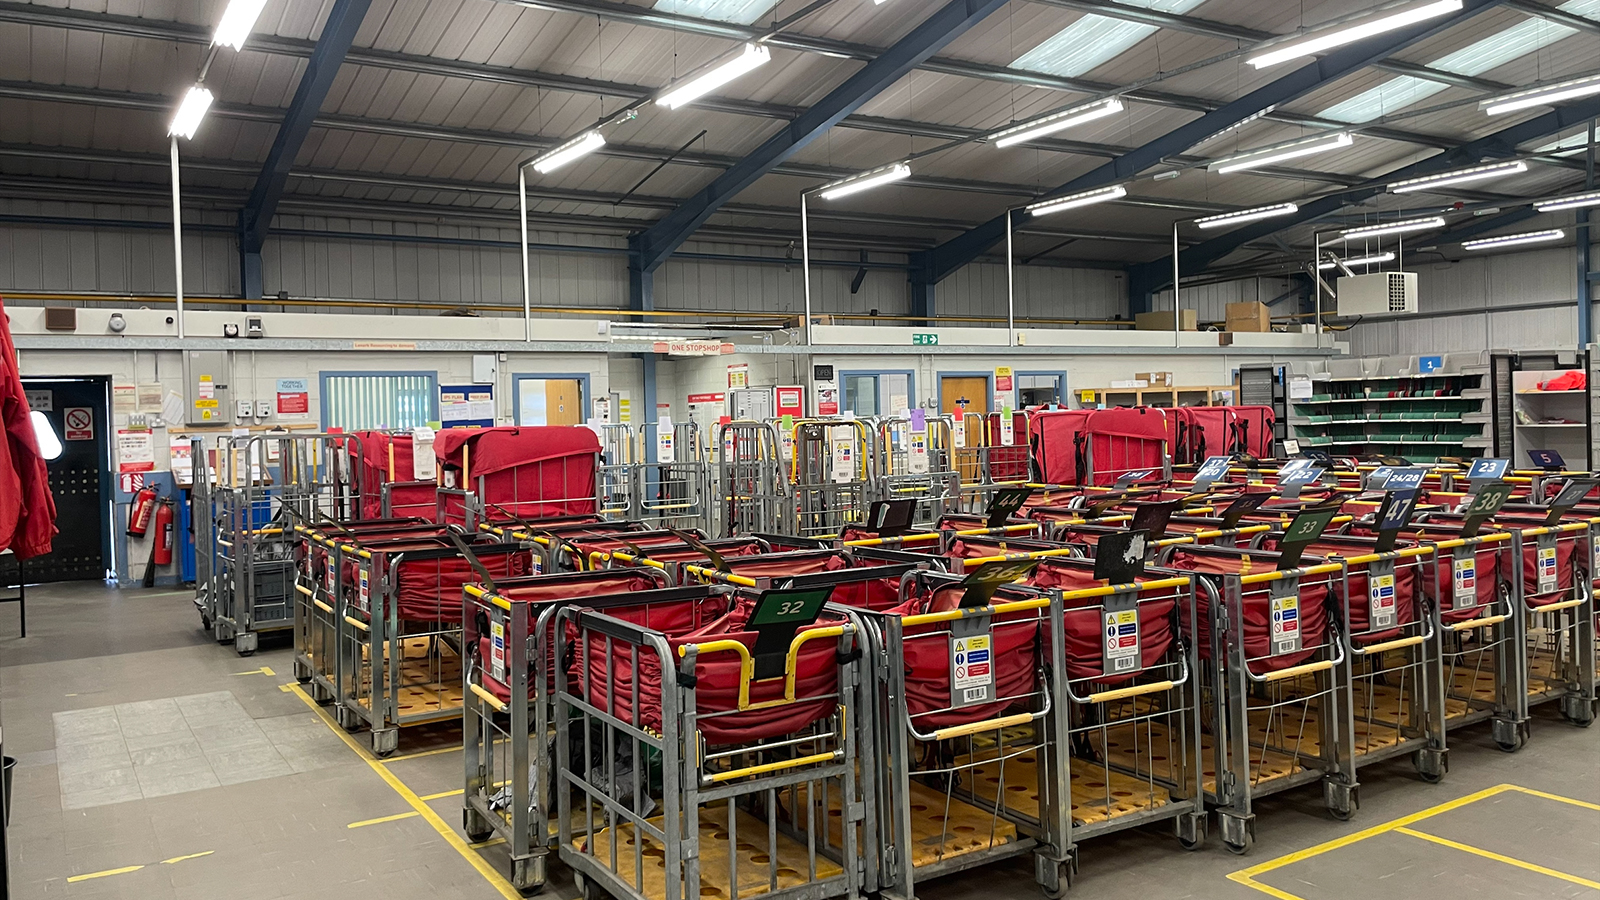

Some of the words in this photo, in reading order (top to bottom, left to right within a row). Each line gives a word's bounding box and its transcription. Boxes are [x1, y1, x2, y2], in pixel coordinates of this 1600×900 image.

[671, 344, 685, 352] ONE
[1427, 360, 1433, 369] 1
[817, 369, 831, 377] OPEN
[1310, 454, 1327, 462] 13
[1540, 453, 1551, 464] 5
[1478, 462, 1497, 472] 23
[1295, 470, 1314, 479] 22
[1390, 474, 1420, 482] 24/28
[1566, 490, 1582, 500] 27
[998, 494, 1021, 507] 44
[1475, 492, 1502, 511] 38
[1385, 499, 1412, 522] 47
[1298, 521, 1318, 534] 33
[776, 600, 805, 615] 32
